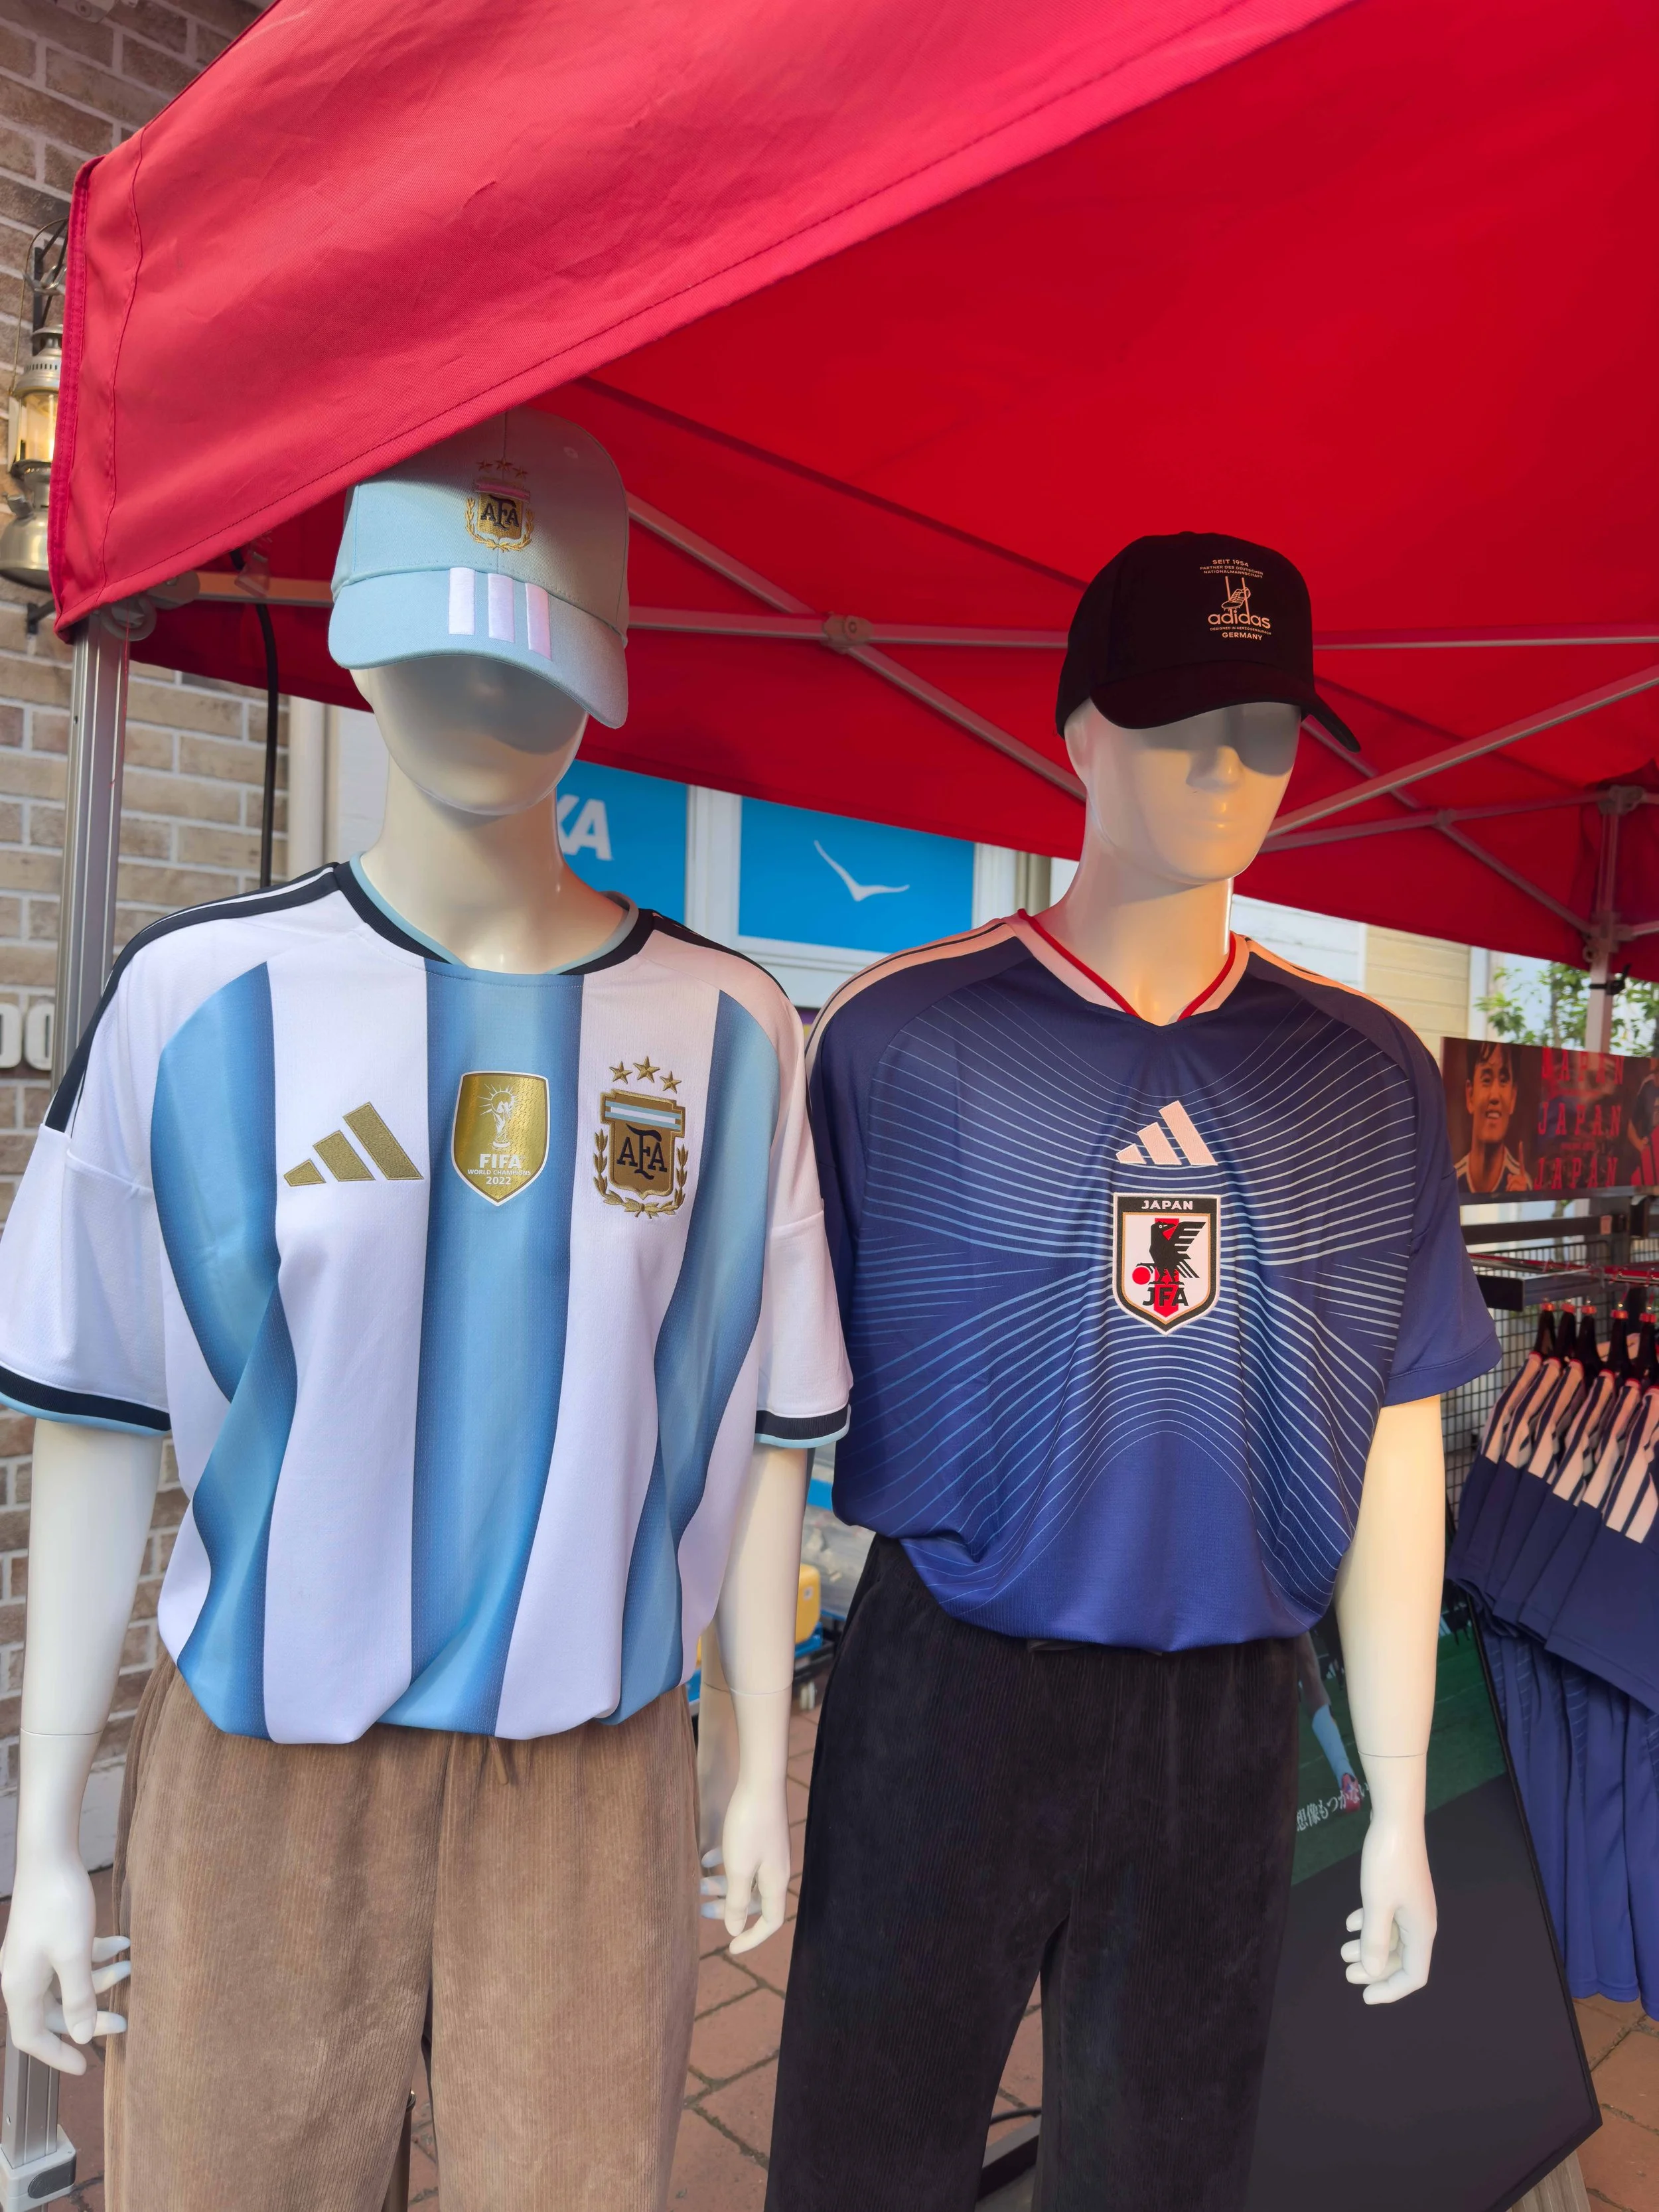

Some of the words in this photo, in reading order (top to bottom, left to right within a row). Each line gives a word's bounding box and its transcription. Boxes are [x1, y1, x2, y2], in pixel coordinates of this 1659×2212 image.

[480, 494, 520, 530] AFA
[1208, 609, 1271, 628] adidas
[1538, 1102, 1622, 1136] JAPAN
[616, 1124, 668, 1180] AFA
[1534, 1157, 1618, 1191] JAPAN
[1141, 1201, 1193, 1210] JAPAN
[1143, 1288, 1189, 1306] JFA
